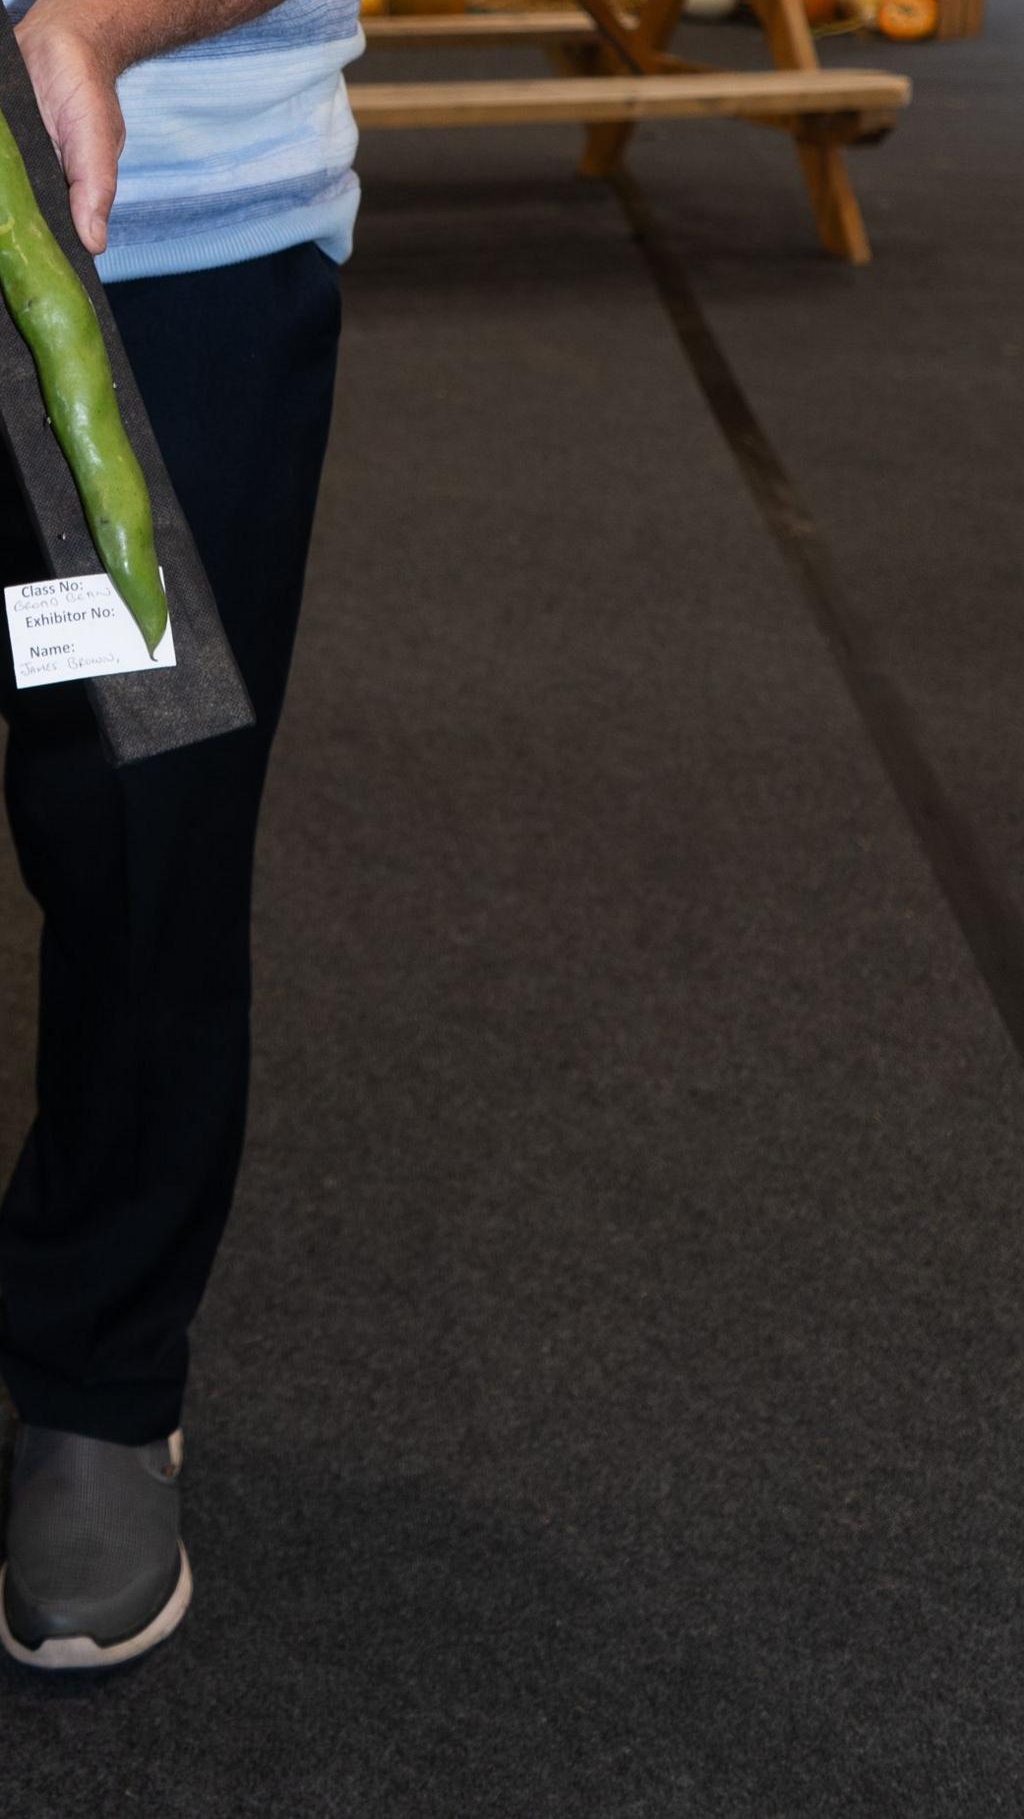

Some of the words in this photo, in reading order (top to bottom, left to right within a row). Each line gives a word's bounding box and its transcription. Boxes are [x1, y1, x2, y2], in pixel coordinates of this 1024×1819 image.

[21, 585, 55, 598] Class
[59, 580, 83, 593] No:
[25, 610, 87, 628] Exhibitor
[91, 606, 115, 620] No:
[29, 643, 75, 659] Name:
